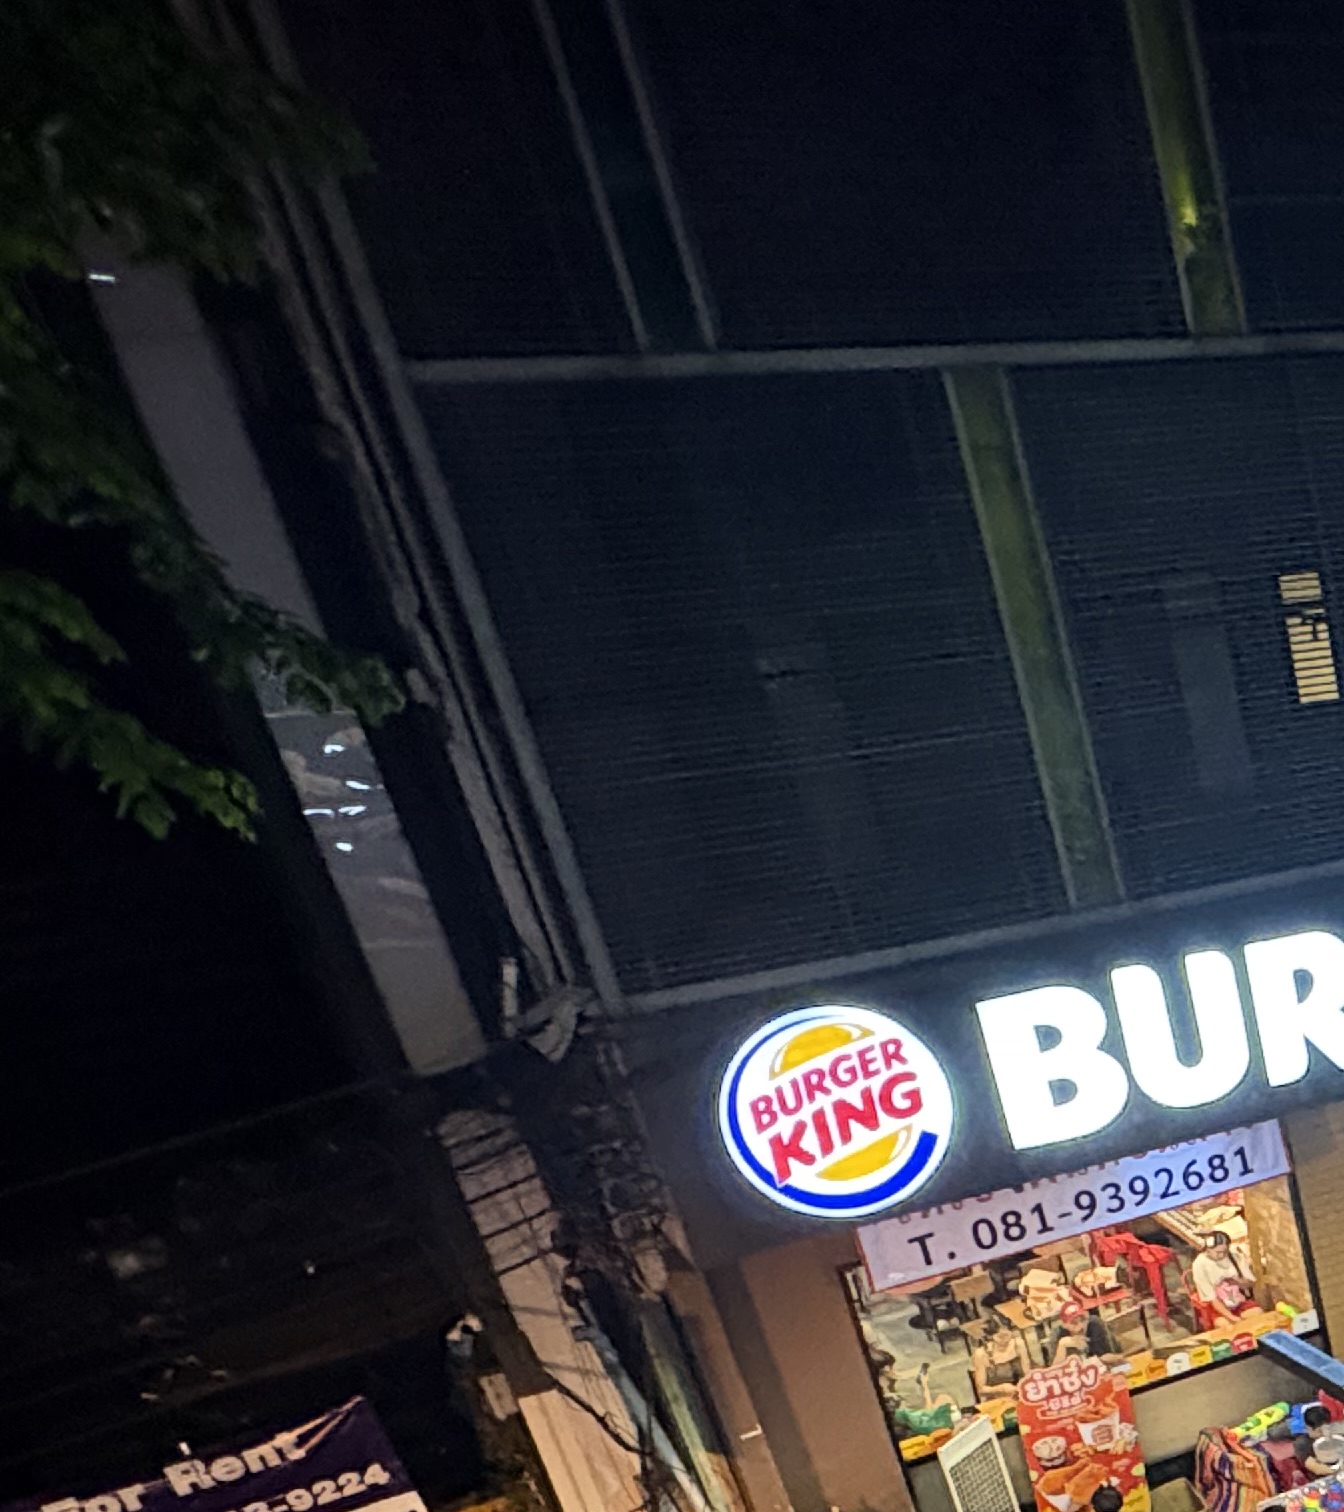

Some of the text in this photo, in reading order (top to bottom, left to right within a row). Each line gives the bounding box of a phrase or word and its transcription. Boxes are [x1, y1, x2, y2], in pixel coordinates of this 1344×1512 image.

[749, 1038, 908, 1135] BURGER
[768, 1071, 923, 1184] KING
[908, 1232, 957, 1266] T.
[971, 1145, 1255, 1251] 081-9392681
[163, 1431, 309, 1497] Rent
